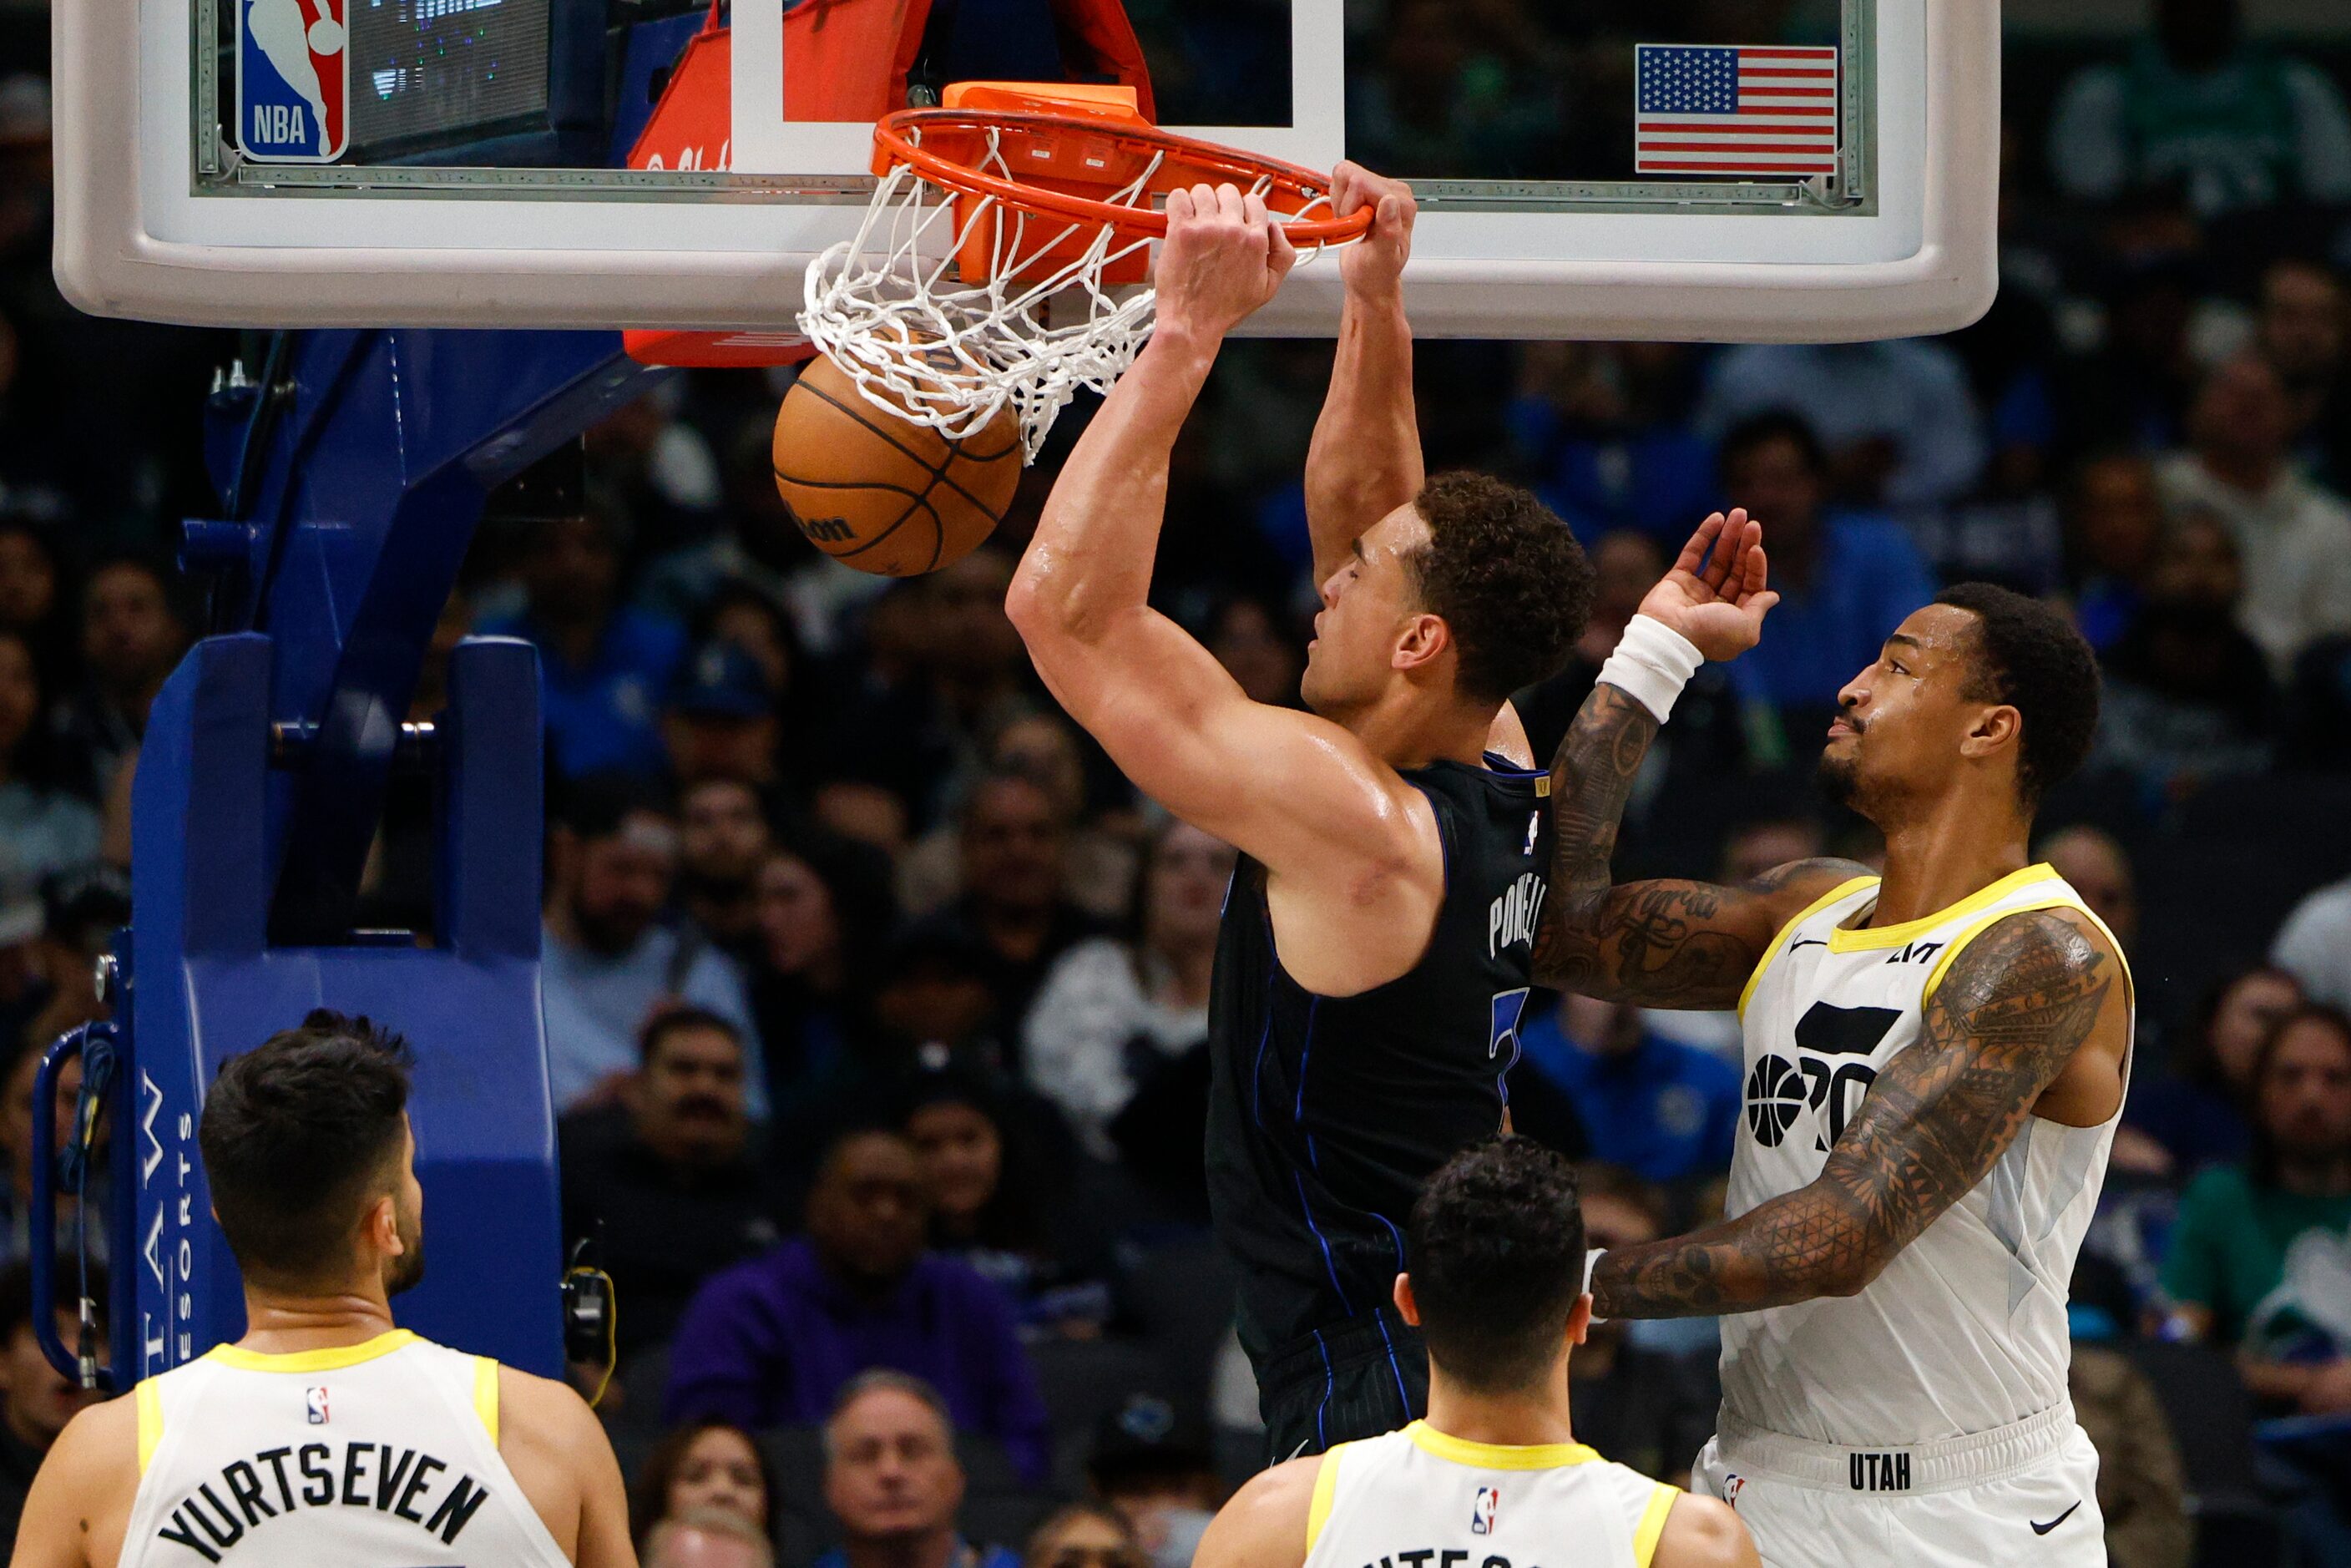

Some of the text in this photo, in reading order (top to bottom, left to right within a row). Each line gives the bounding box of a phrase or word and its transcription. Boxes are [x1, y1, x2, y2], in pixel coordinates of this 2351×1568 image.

[254, 105, 306, 144] NBA
[1849, 1452, 1911, 1491] UTAH
[158, 1442, 490, 1565] YURTSEVEN
